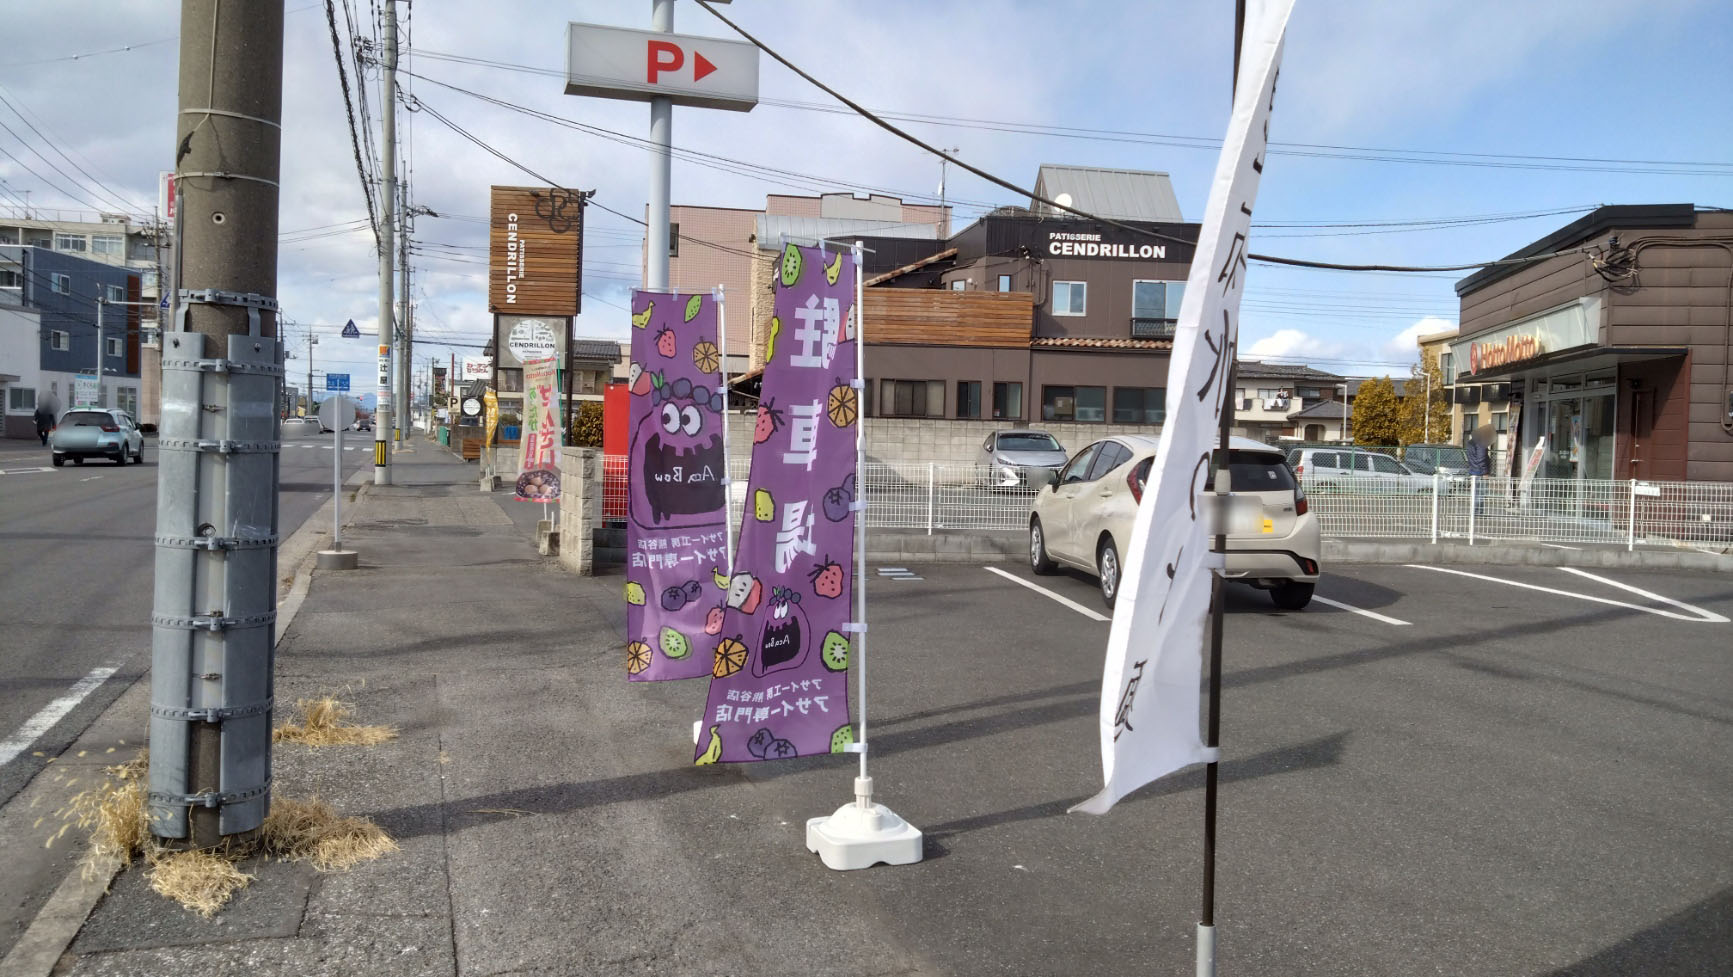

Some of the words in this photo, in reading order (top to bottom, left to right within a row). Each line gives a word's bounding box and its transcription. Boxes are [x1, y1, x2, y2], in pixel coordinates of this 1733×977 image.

[647, 39, 685, 84] P
[1049, 232, 1102, 242] PATISSERIE
[507, 212, 518, 304] CENDRILLON
[1049, 241, 1166, 259] CENDRILLON
[450, 397, 458, 408] P
